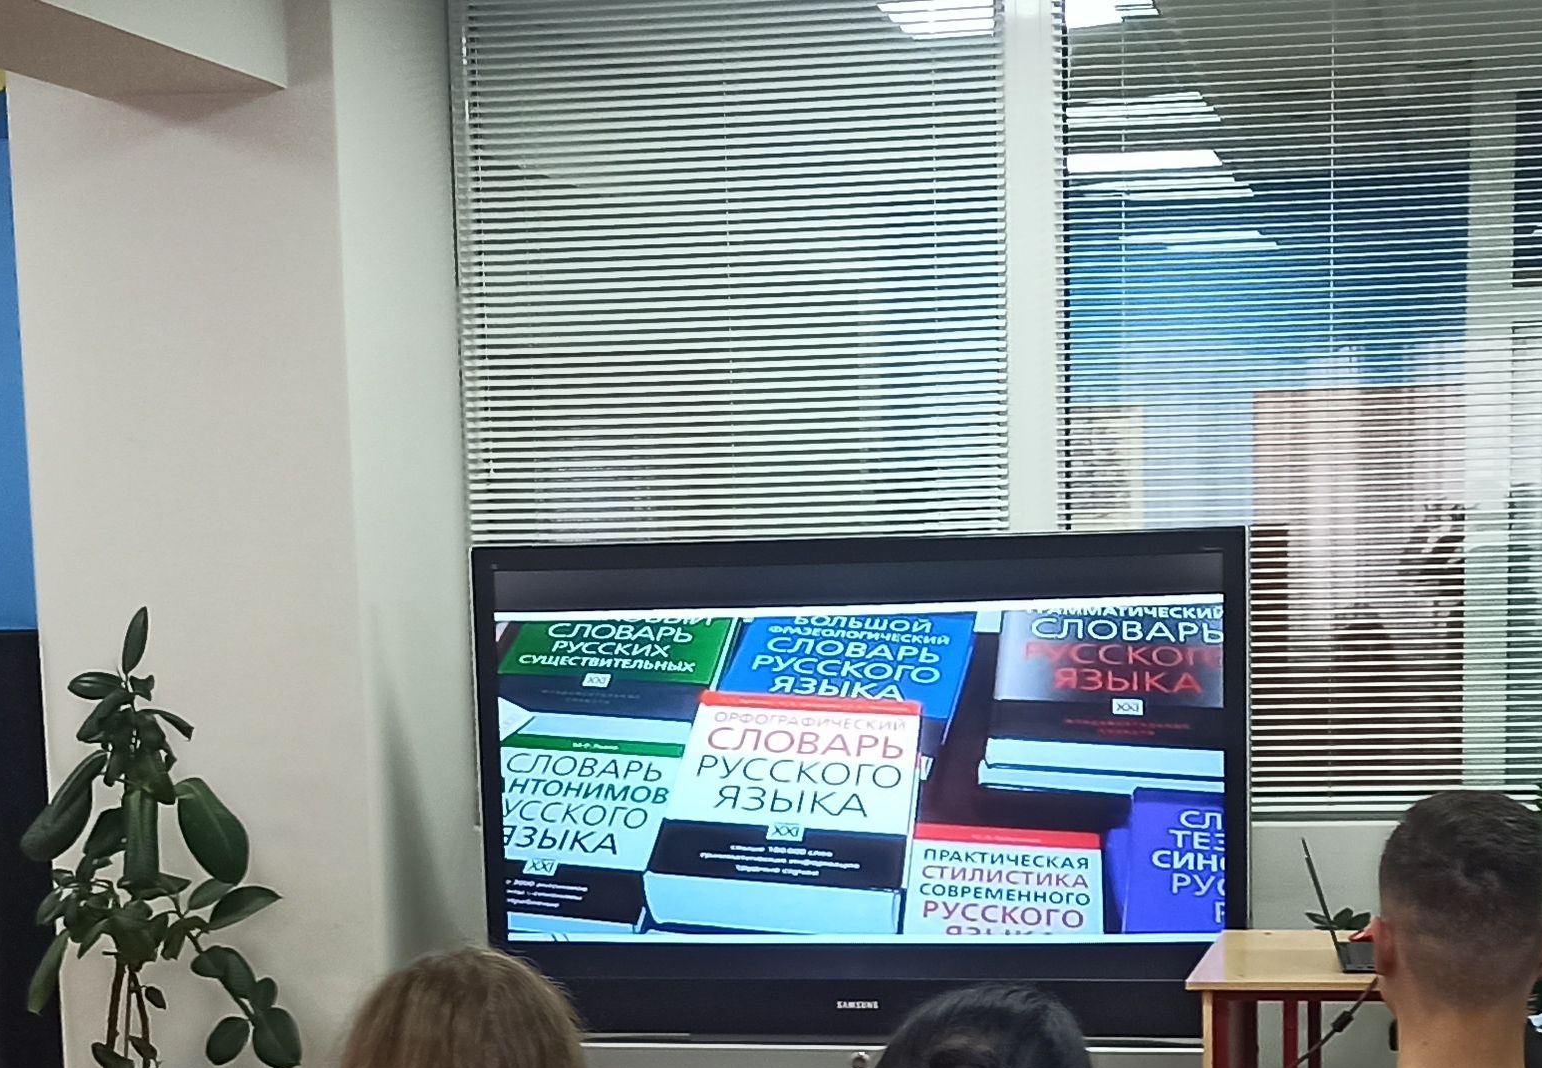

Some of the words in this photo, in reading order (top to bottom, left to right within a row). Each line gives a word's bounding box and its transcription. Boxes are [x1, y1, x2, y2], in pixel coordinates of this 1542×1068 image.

[548, 622, 693, 643] СЛОВАРЬ
[768, 625, 950, 646] ФРАЗЕОЛОГИЧЕСКИЙ
[794, 615, 932, 634] БОЛЬШОЙ
[1031, 617, 1224, 643] СЛОВАРЬ
[551, 640, 671, 658] РУССКИХ
[767, 636, 940, 664] СЛОВАРЬ
[518, 654, 696, 673] СУЩЕСТВИТЕЛЬНЫХ
[751, 655, 941, 684] РУССКОГО
[769, 676, 905, 703] ЯЗЫКА
[1053, 667, 1203, 694] ЯЗЫКА
[714, 711, 907, 732] ОРФОГРАФИЧЕСКИЙ
[708, 727, 904, 759] СЛОВАРЬ
[506, 753, 662, 782] СЛОВАРЬ
[696, 755, 902, 789] РУССКОГО
[503, 778, 670, 804] НТОНИМОВ
[713, 786, 868, 818] ЯЗЫКА
[923, 848, 1089, 870] ПРАКТИЧЕСКАЯ
[922, 865, 1089, 889] СТИЛИСТИКА
[919, 883, 1091, 906] СОВРЕМЕННОГО
[922, 900, 1084, 929] РУССКОГО
